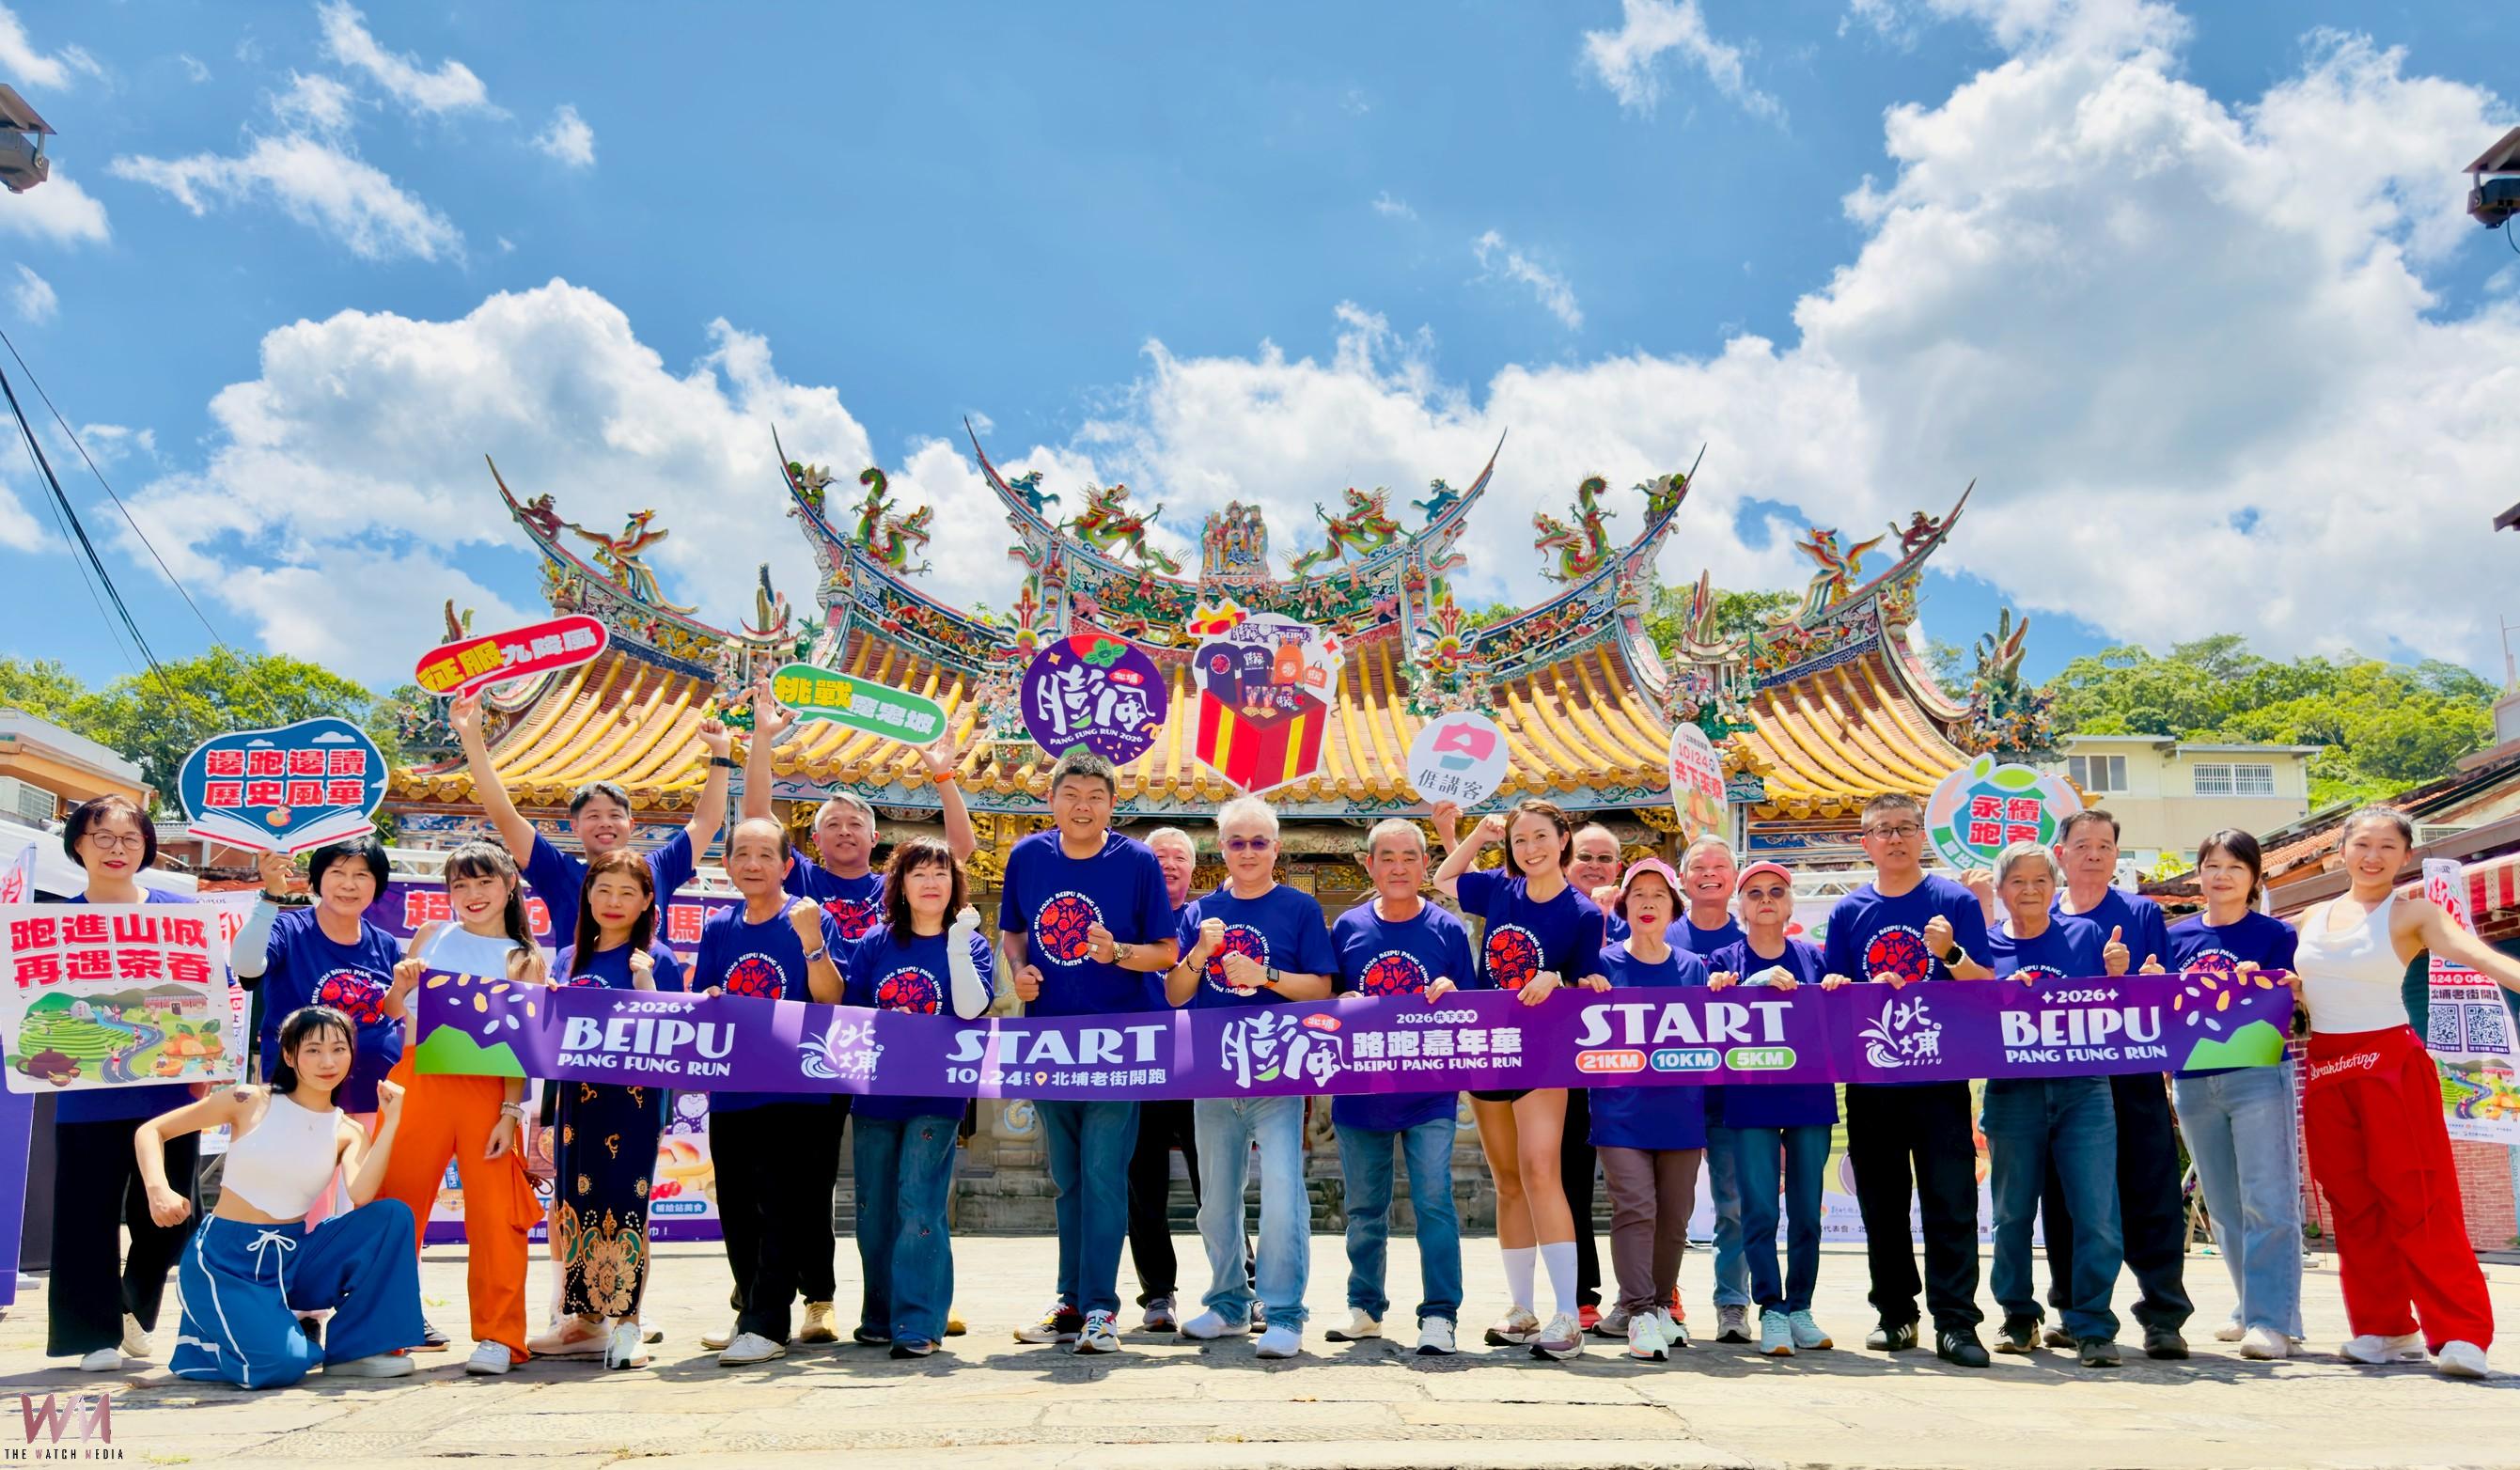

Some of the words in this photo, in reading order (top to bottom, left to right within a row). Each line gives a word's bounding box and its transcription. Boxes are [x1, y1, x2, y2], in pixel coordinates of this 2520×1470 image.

[1050, 733, 1074, 745] PANG
[1075, 728, 1098, 740] FUNG
[1119, 732, 1143, 743] 2026
[206, 749, 367, 777] 邊跑邊讀
[203, 780, 365, 807] 歷史風華
[1971, 795, 2040, 822] 永續
[10, 913, 210, 953] 跑進山城
[13, 949, 212, 989] 再遇茶香
[629, 1001, 681, 1014] 2026
[2057, 990, 2106, 1004] 2026
[1396, 1013, 1433, 1024] 2026
[1574, 1000, 1793, 1046] START
[2000, 1006, 2162, 1047] BEIPU
[560, 1016, 736, 1059] BEIPU
[946, 1024, 1167, 1065] START
[1352, 1028, 1523, 1058] 路跑嘉年華
[557, 1053, 618, 1069] PANG
[624, 1056, 681, 1073] FUNG
[687, 1061, 731, 1077] RUN
[1354, 1059, 1397, 1072] BEIPU
[1402, 1058, 1444, 1071] PANG
[1448, 1057, 1488, 1070] FUNG
[1493, 1056, 1522, 1068] RUN
[1582, 1053, 1639, 1069] 21KM
[1656, 1051, 1714, 1068] 10KM
[1736, 1051, 1784, 1067] 5KM
[2005, 1049, 2060, 1064] PANG
[2065, 1047, 2120, 1062] FUNG
[2125, 1045, 2168, 1059] RUN
[946, 1067, 1023, 1087] 10.24
[1052, 1068, 1166, 1087] 北埔老街開跑
